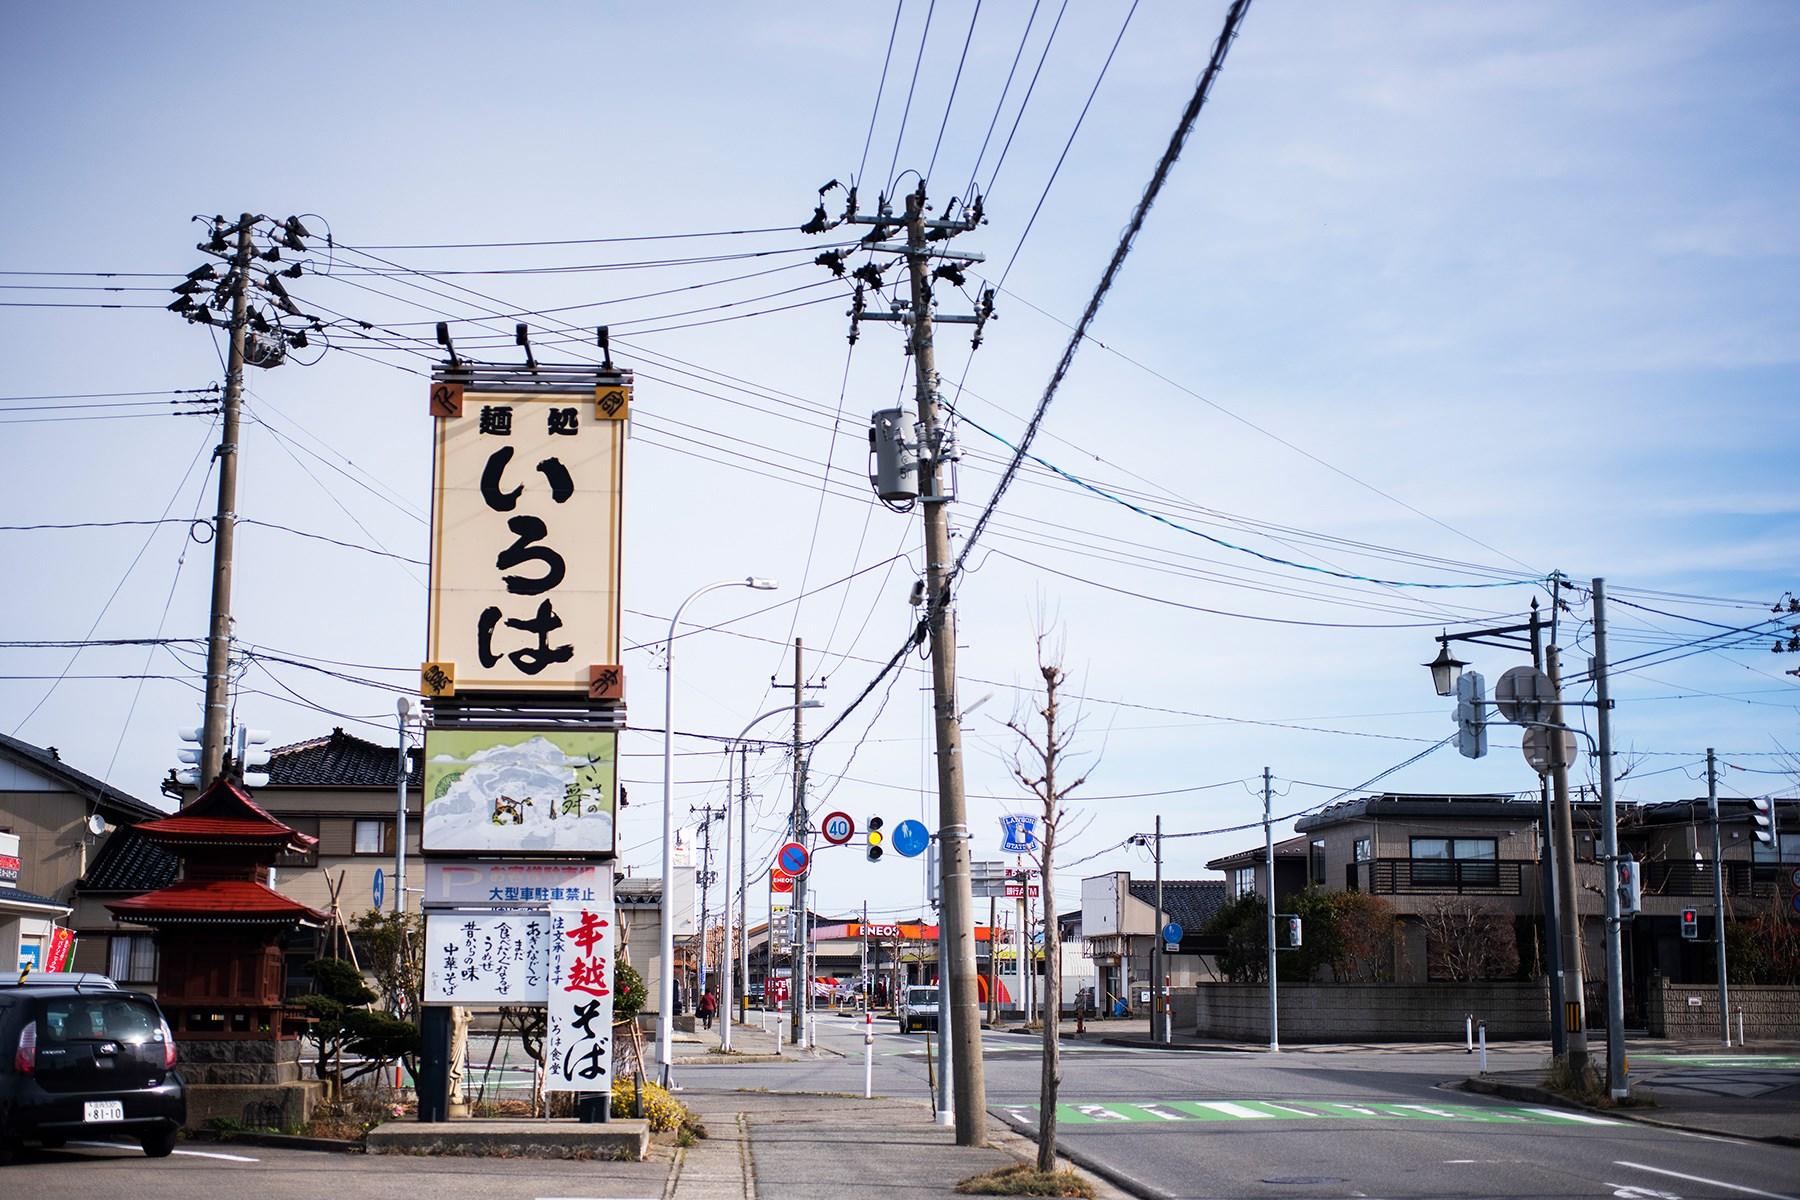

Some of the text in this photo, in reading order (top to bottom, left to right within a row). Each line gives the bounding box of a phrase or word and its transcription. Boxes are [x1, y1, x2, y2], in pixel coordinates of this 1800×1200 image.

[478, 446, 575, 675] いろは
[829, 820, 848, 836] 40
[489, 886, 596, 901] 大型車駐車禁止
[460, 921, 482, 982] 昔からの味
[514, 940, 525, 960] まだ
[551, 916, 565, 986] 注文承ります
[859, 926, 900, 937] ENEOS
[442, 943, 459, 996] 中華そば
[563, 908, 610, 1082] 年越そば
[549, 1015, 562, 1075] いろは食堂
[93, 1108, 121, 1120] 81-10
